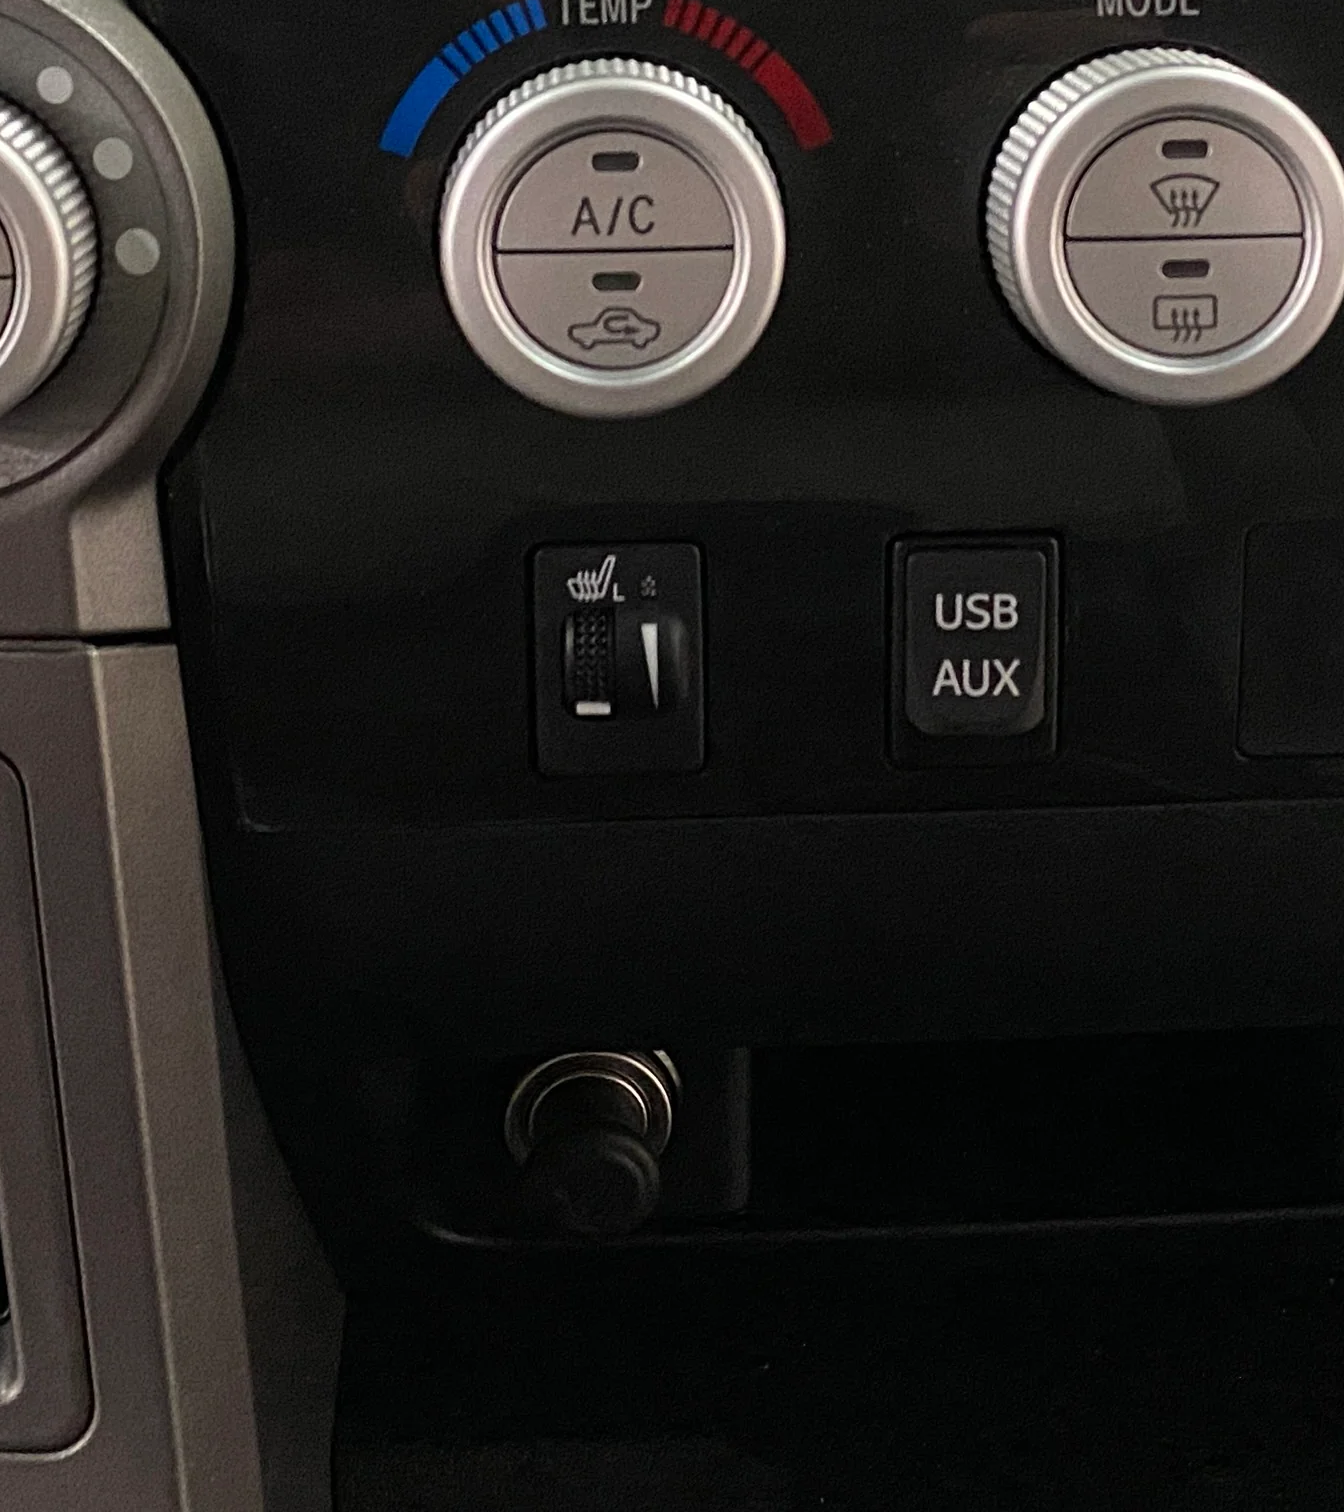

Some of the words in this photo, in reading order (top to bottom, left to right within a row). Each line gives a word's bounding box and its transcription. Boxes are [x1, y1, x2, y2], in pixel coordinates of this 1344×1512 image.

[570, 194, 656, 237] A/C
[611, 582, 626, 603] L
[934, 593, 1020, 631] USB
[932, 659, 1021, 698] AUX
